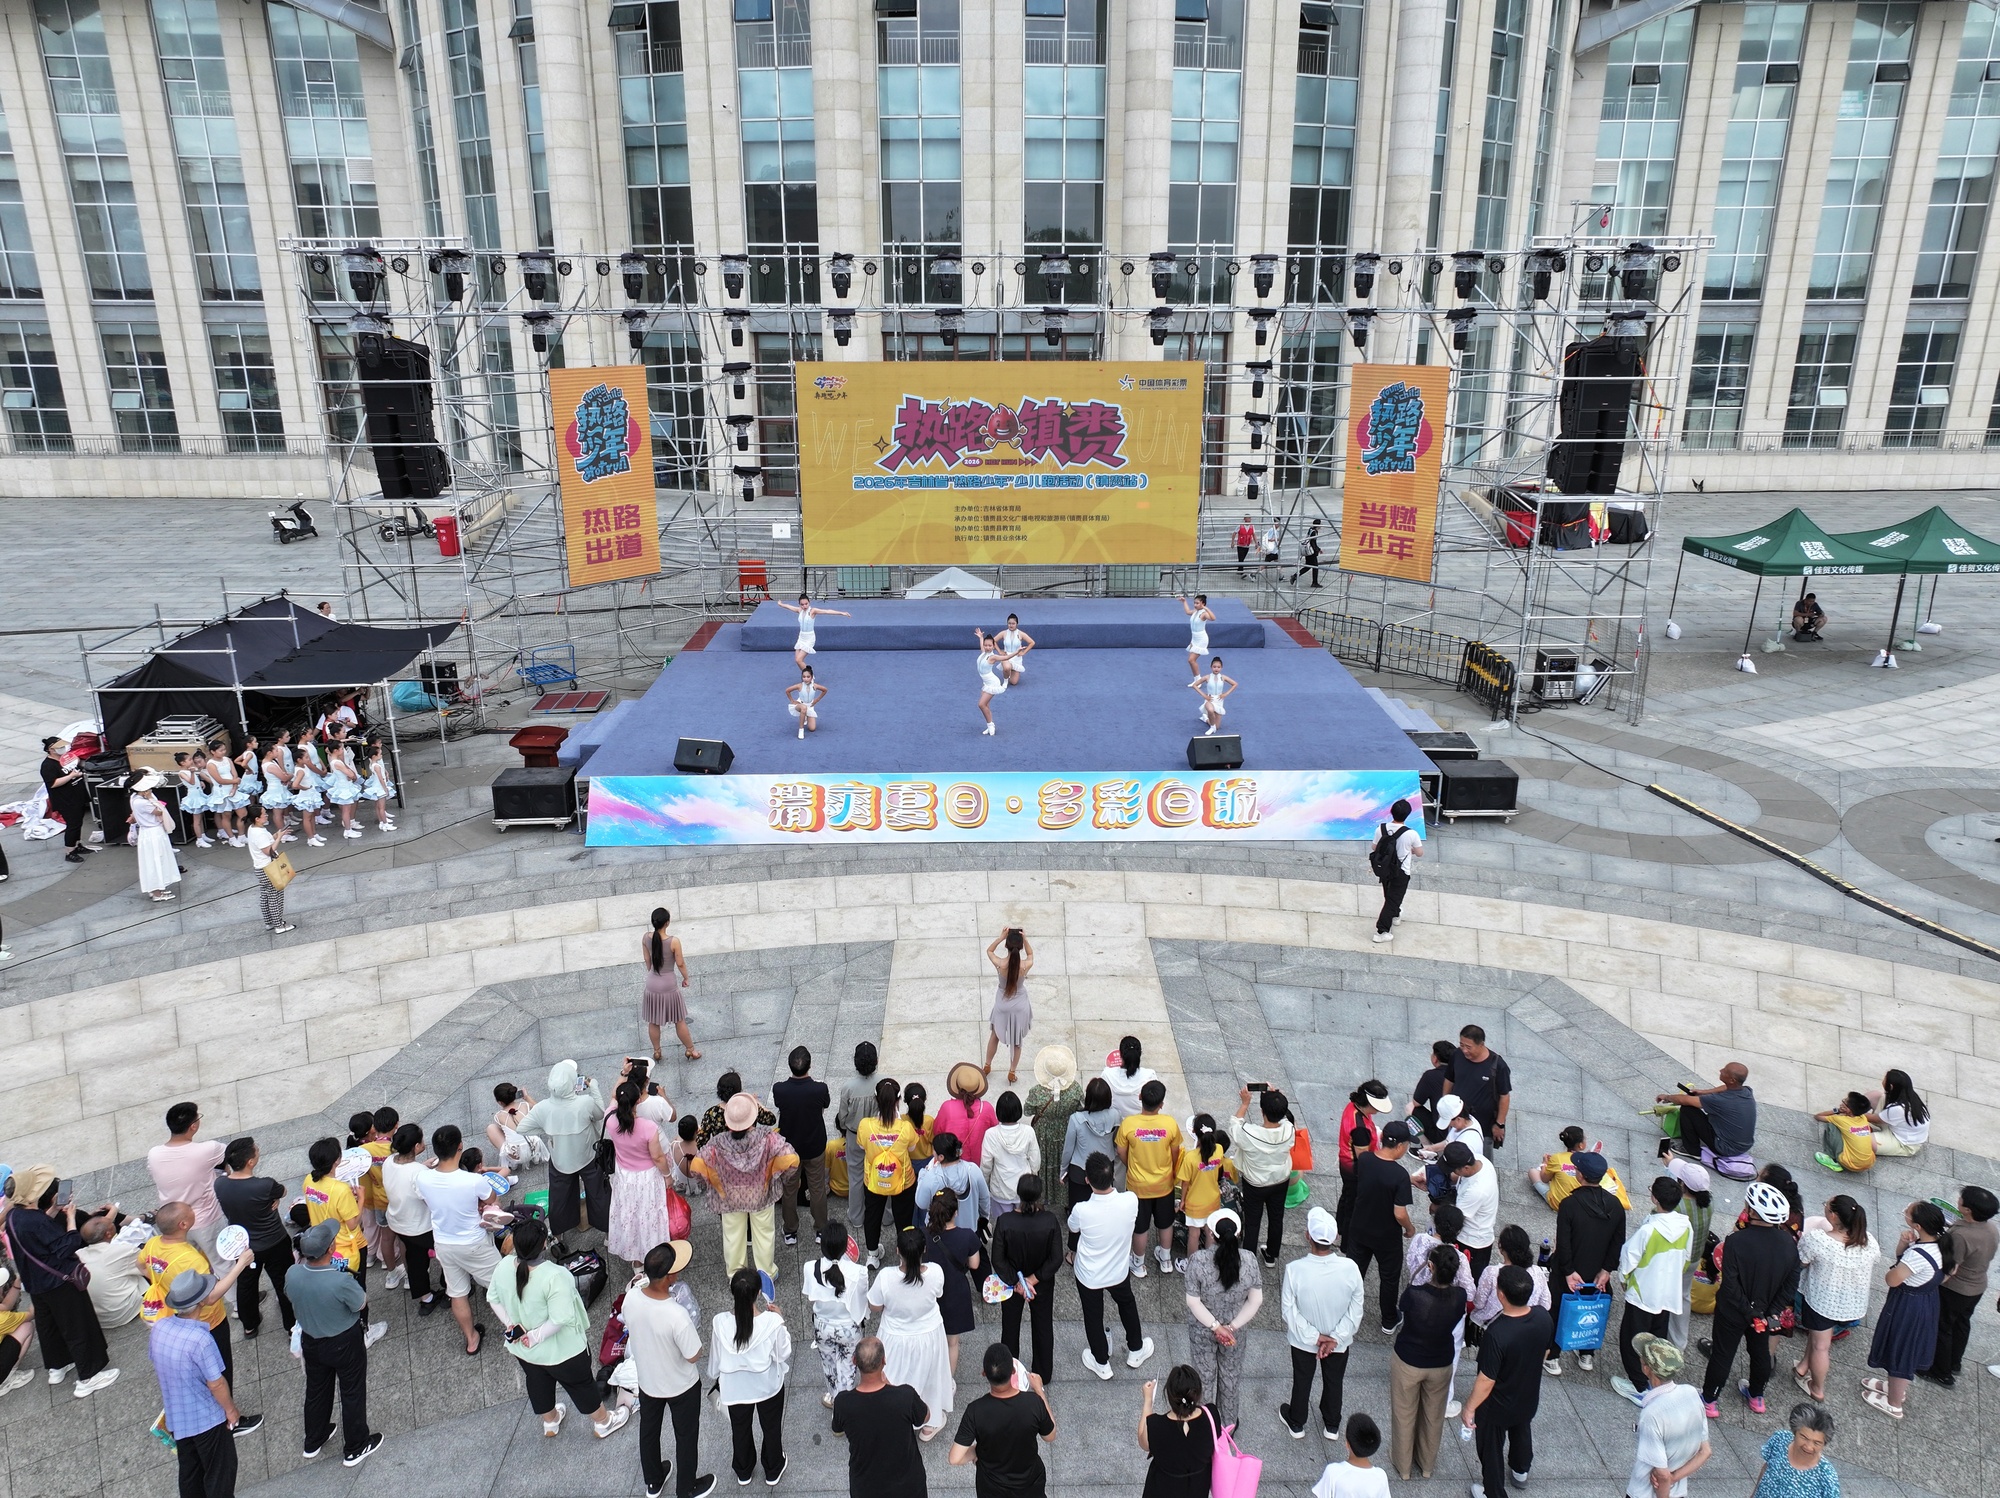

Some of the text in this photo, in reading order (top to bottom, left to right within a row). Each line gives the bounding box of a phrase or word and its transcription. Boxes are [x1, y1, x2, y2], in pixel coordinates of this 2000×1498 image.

[1138, 378, 1188, 387] 中国体育彩票
[582, 504, 641, 535] 热路
[1358, 502, 1418, 533] 当燃
[585, 532, 643, 565] 出道
[1357, 532, 1415, 561] 少年
